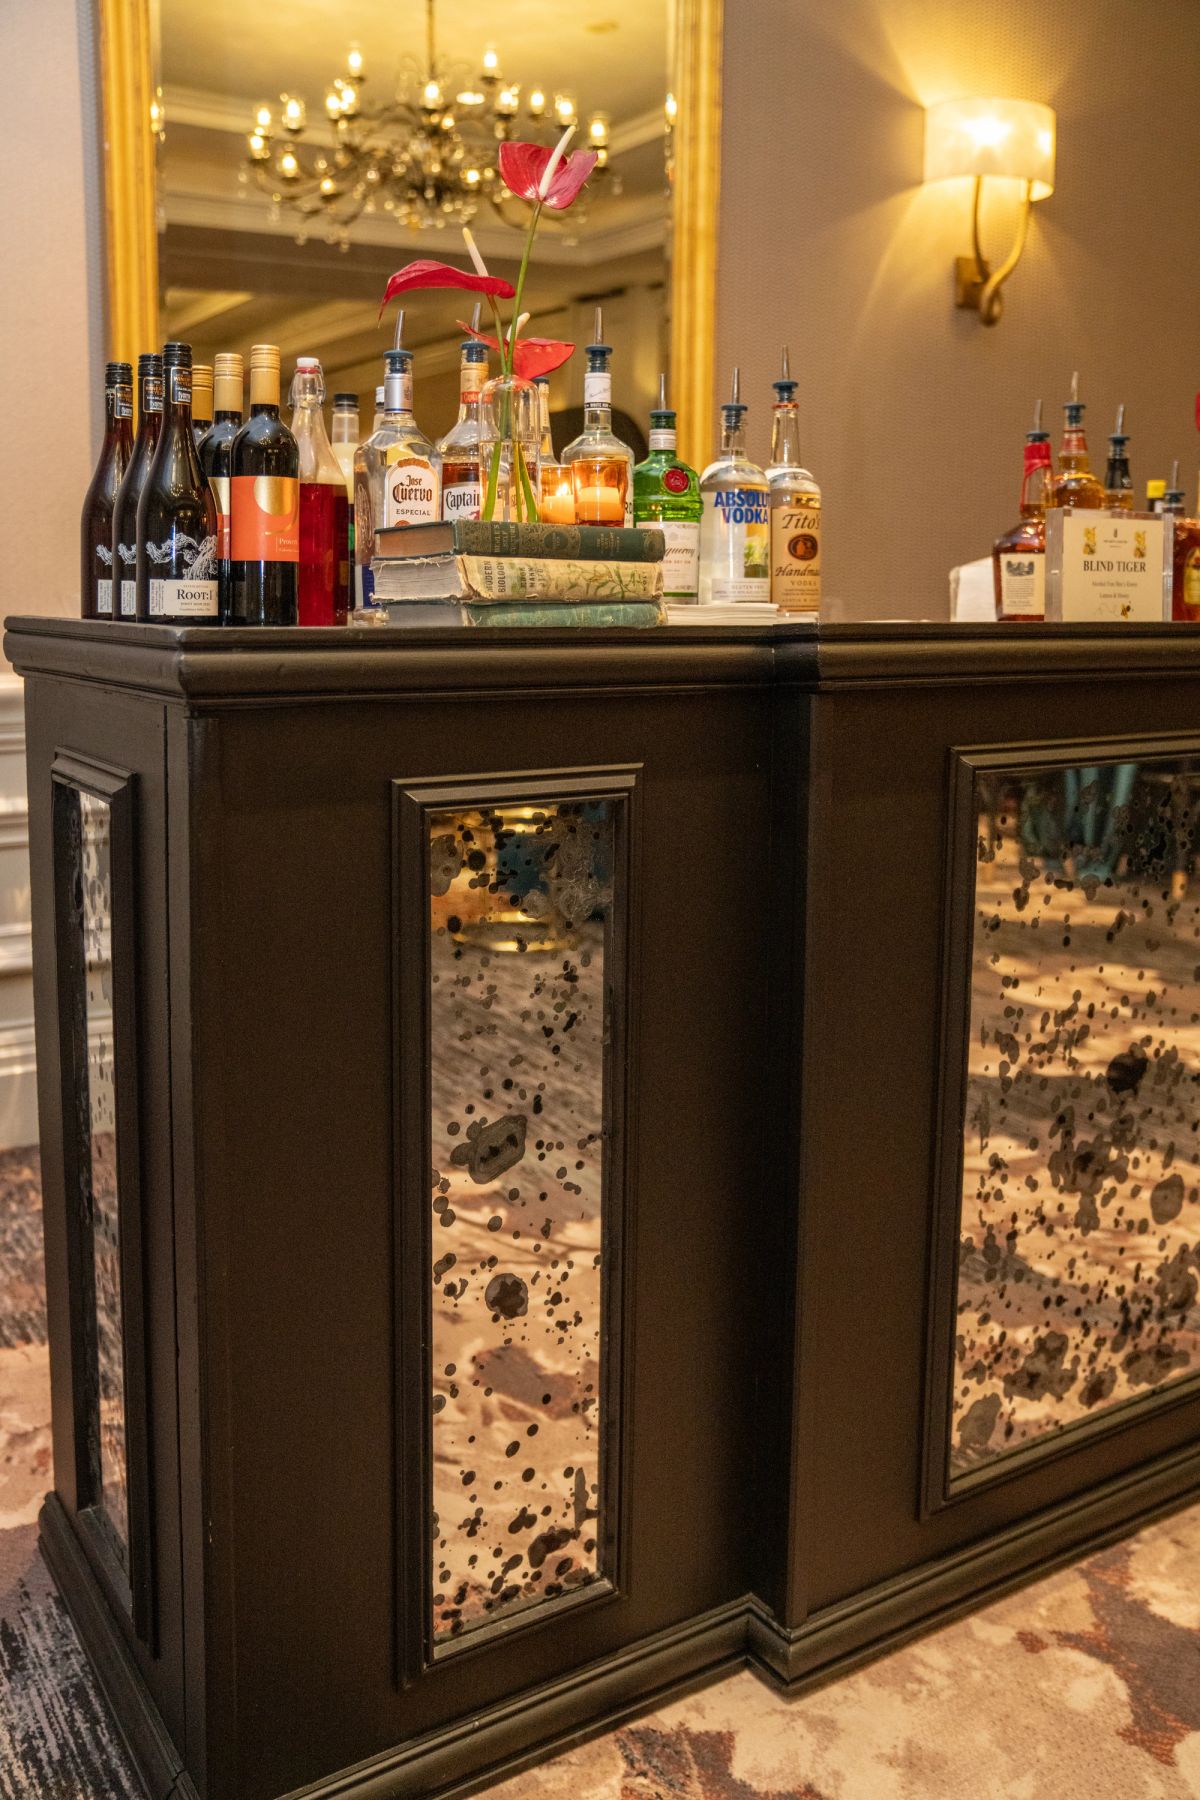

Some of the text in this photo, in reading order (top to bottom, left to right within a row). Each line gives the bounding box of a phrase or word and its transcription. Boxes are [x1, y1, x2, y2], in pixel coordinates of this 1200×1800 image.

[405, 474, 422, 487] Jose
[392, 482, 433, 504] Cuervo
[395, 508, 431, 516] ESPECIAL
[1083, 560, 1147, 573] BLIND TIGER
[496, 560, 506, 593] BIOLOGY
